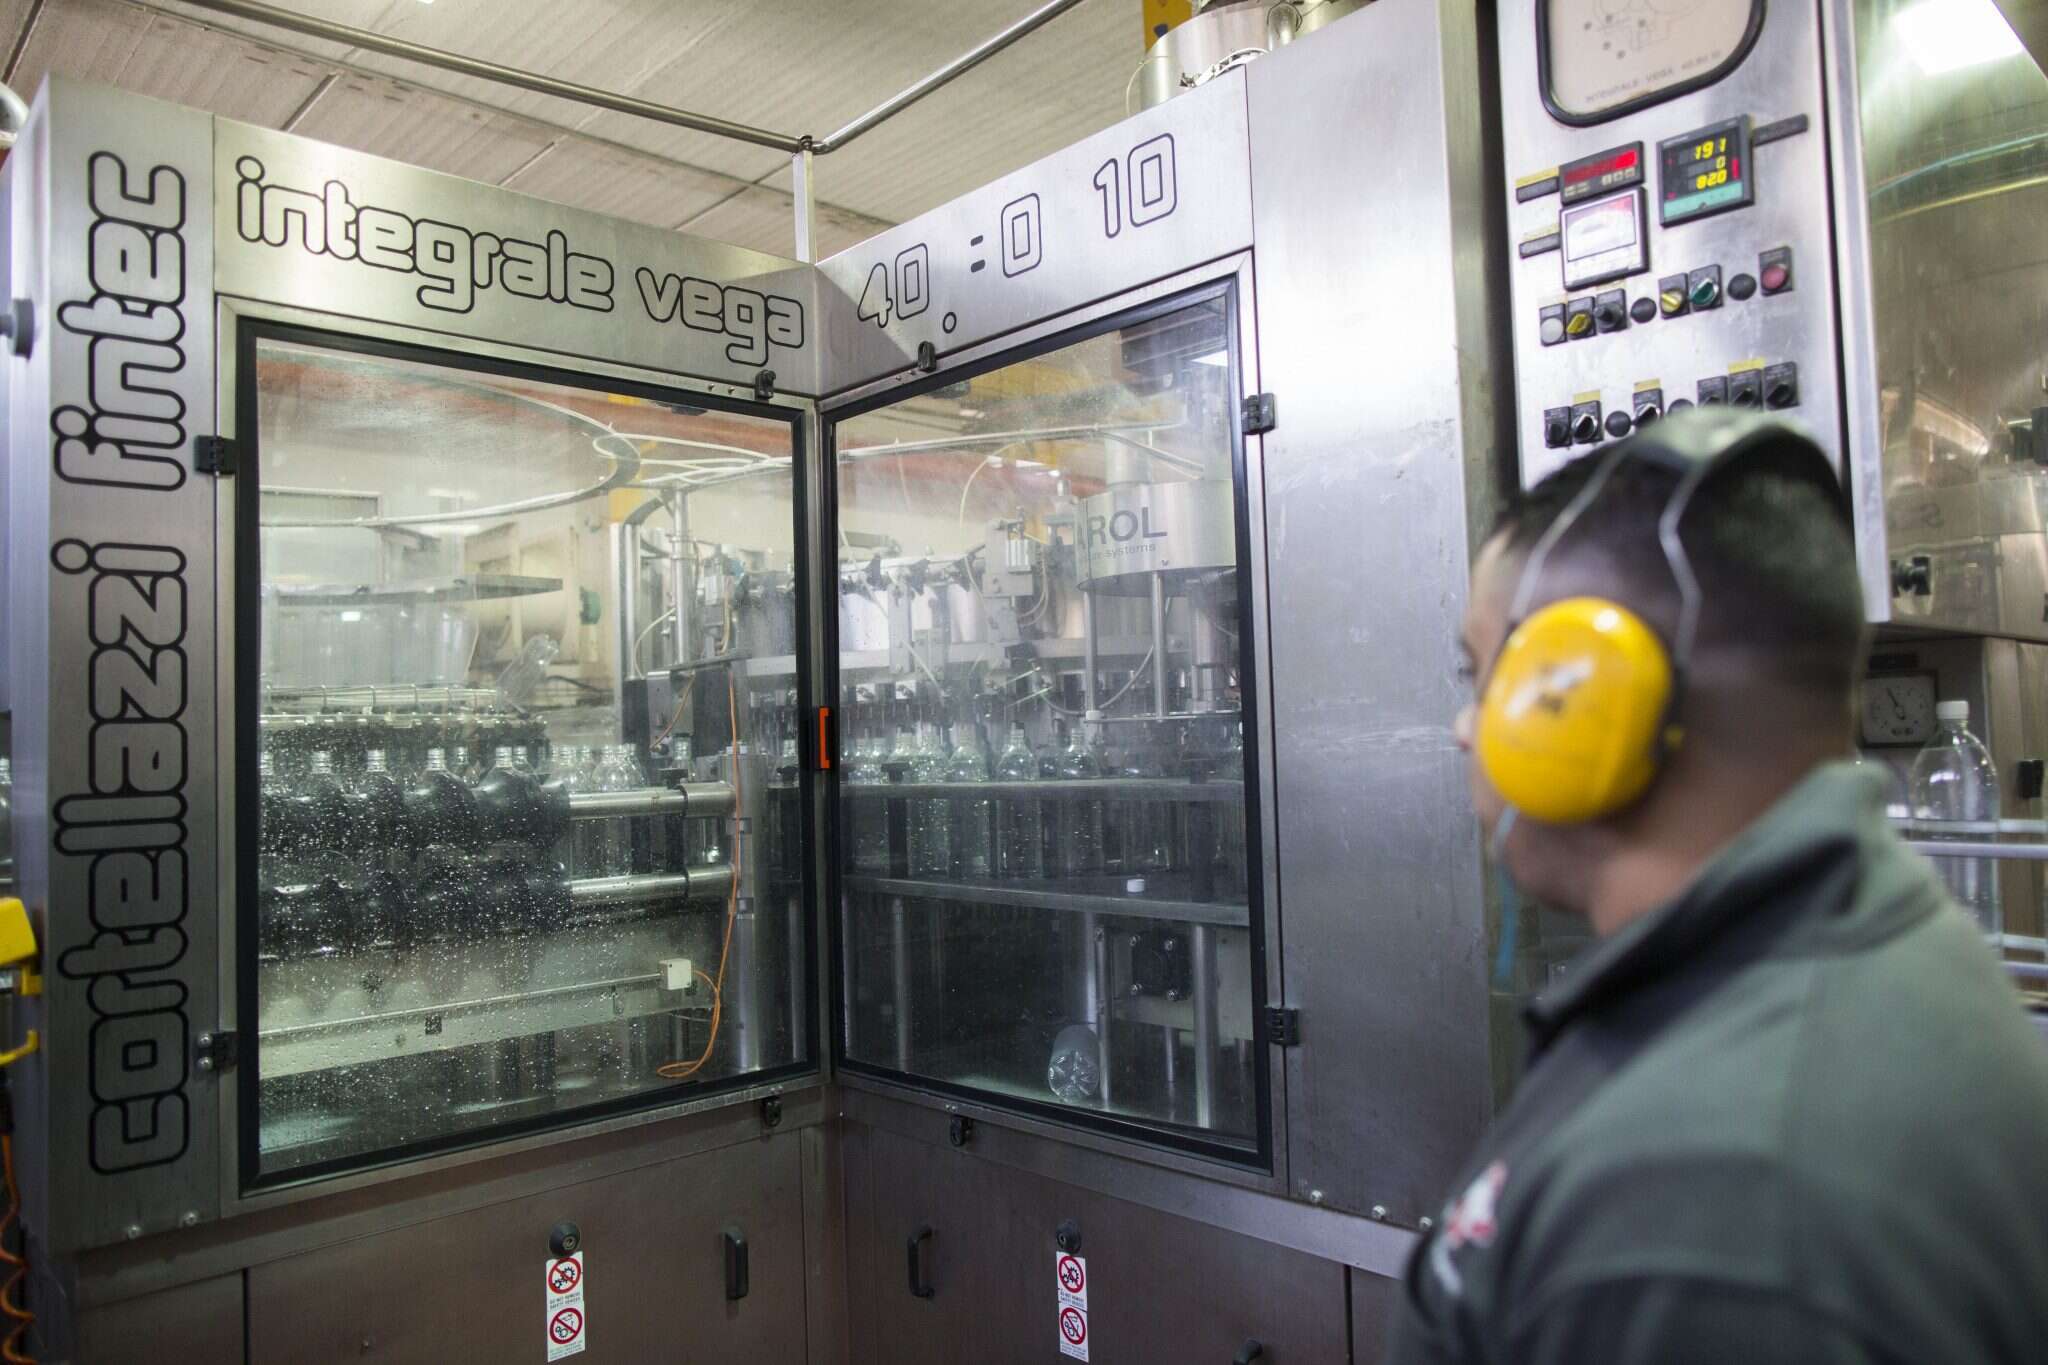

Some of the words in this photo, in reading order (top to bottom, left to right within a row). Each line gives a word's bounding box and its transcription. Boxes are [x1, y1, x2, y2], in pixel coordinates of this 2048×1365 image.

[236, 155, 614, 314] integrale
[635, 267, 805, 367] vega
[1093, 132, 1177, 238] 10
[51, 150, 187, 491] fintec
[1081, 507, 1168, 546] ROL
[52, 540, 190, 1175] cortellazzi
